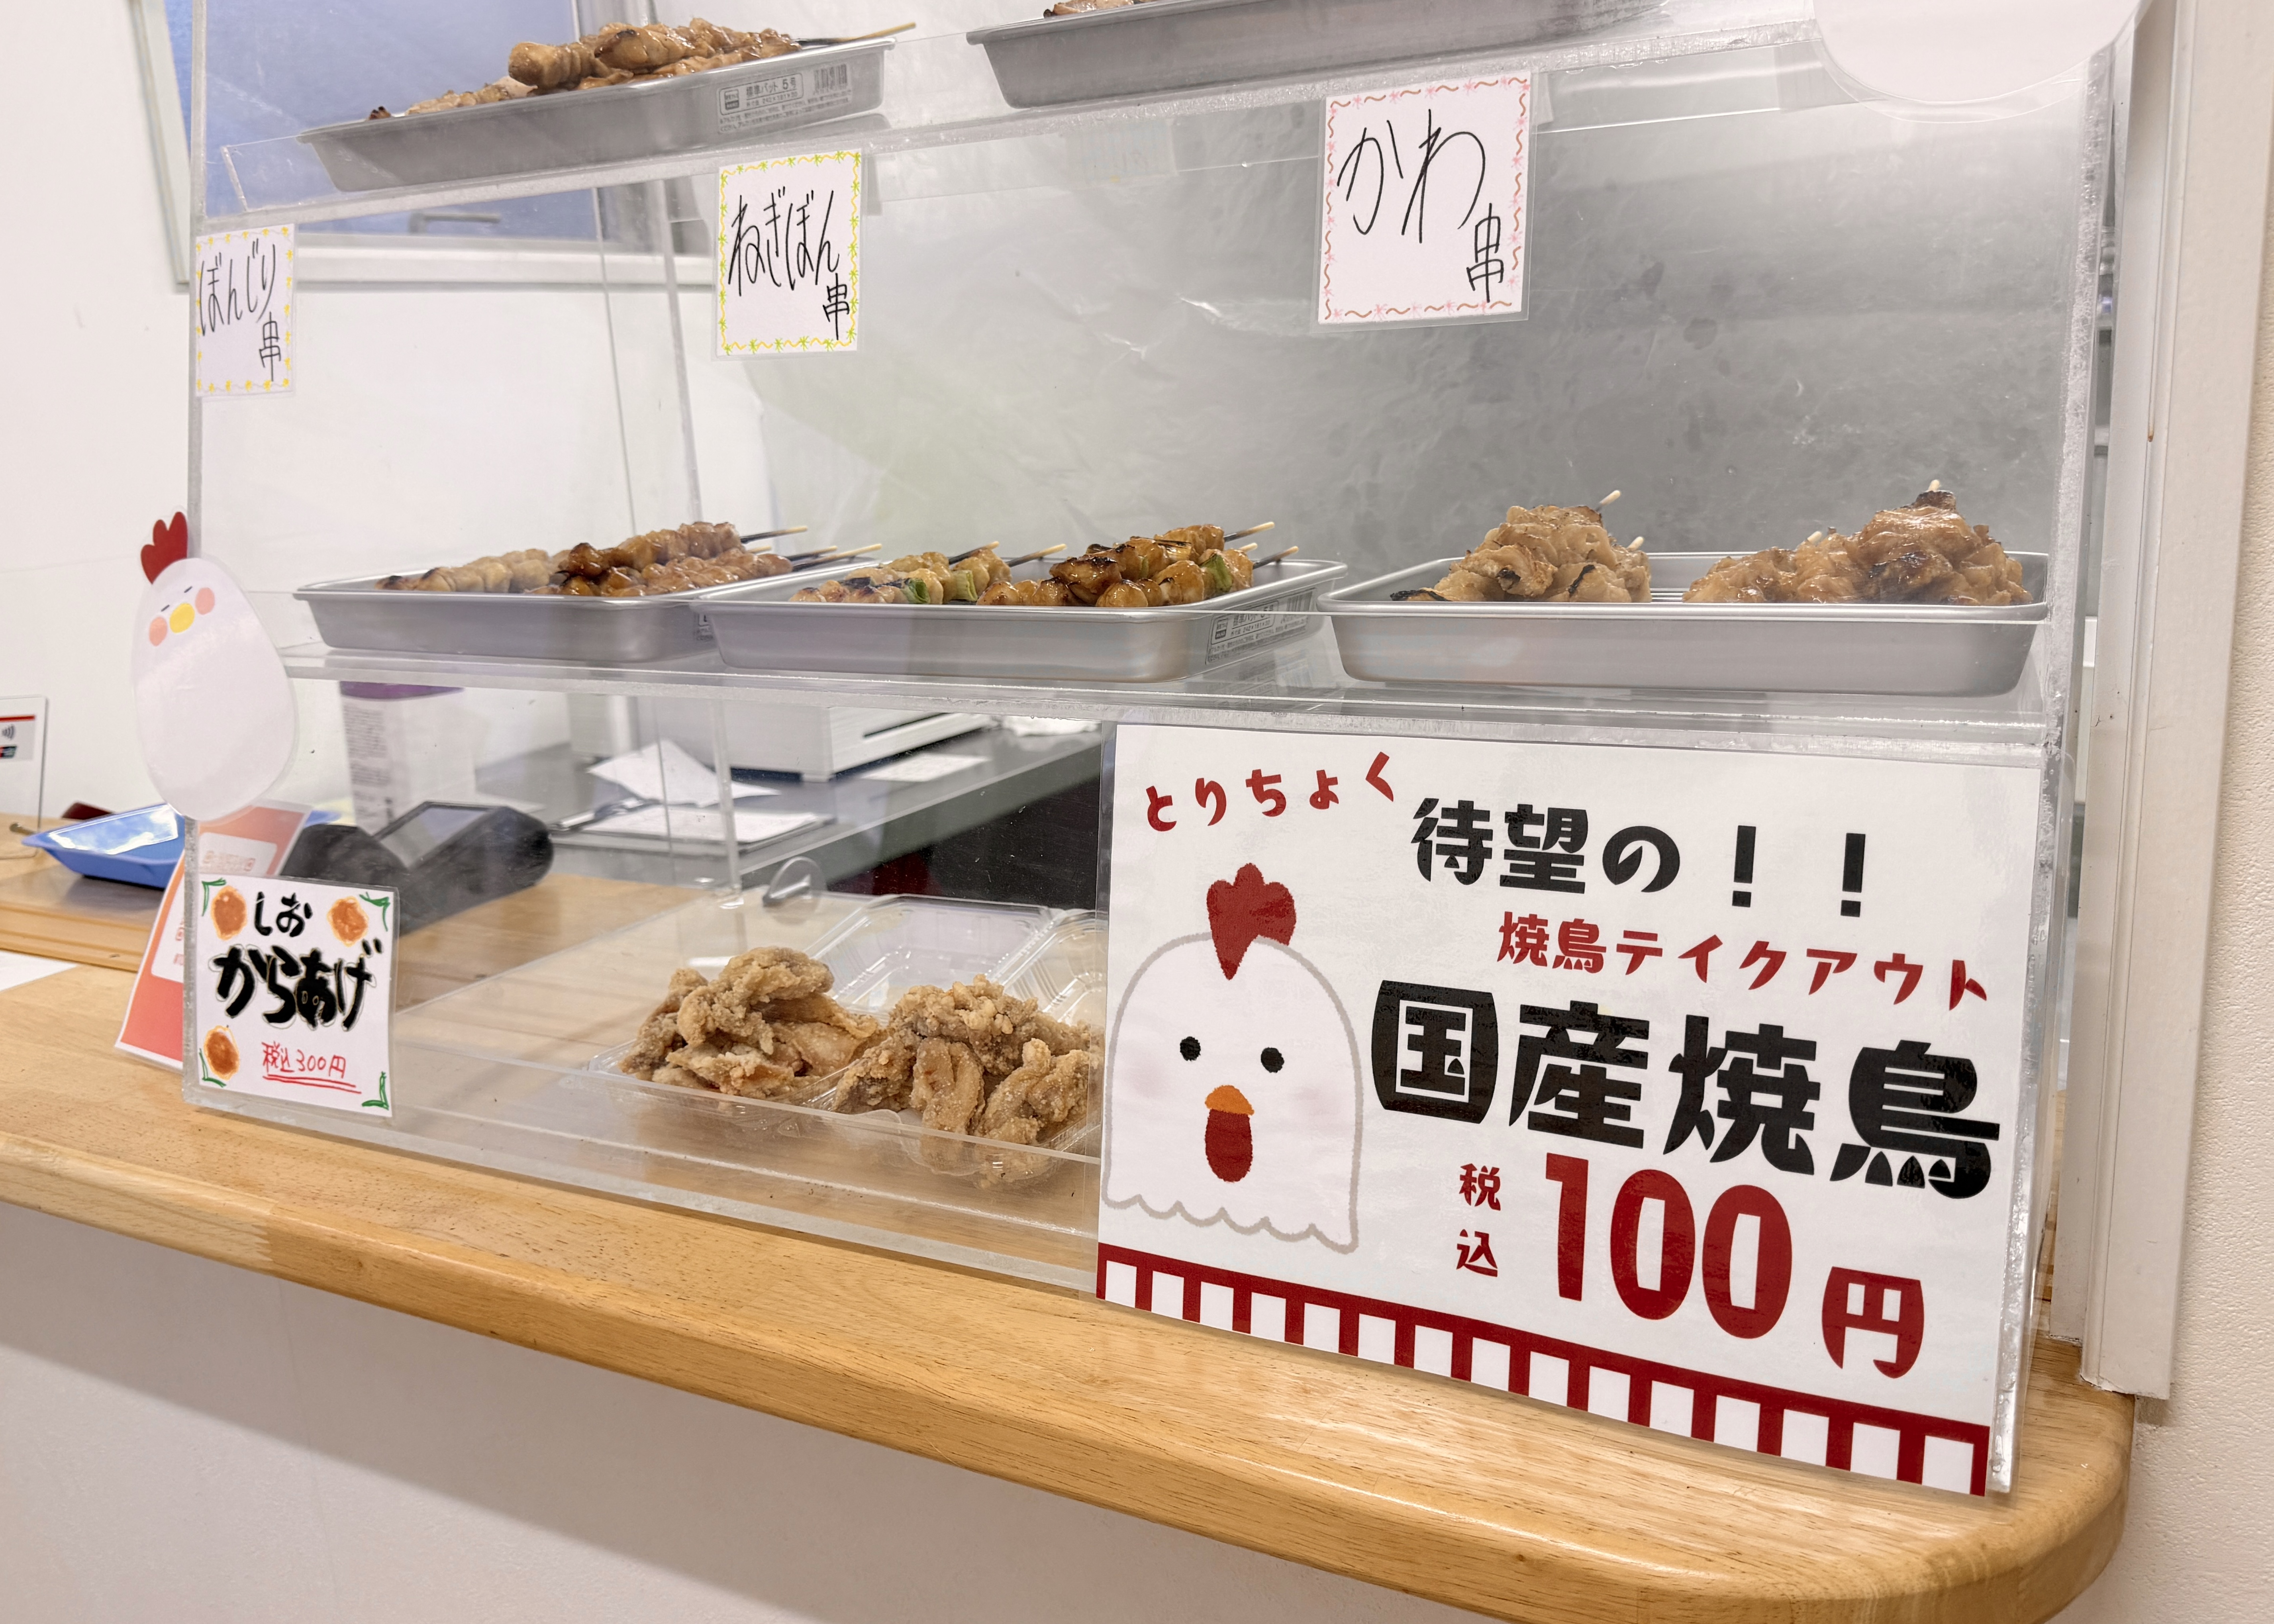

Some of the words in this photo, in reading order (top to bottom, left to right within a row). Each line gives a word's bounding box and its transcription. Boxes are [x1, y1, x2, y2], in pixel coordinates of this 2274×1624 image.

[782, 77, 796, 90] 5号
[1337, 109, 1486, 244] かわ
[200, 238, 276, 337] ぼんじり
[728, 186, 839, 297] ねぎぼん
[1466, 203, 1504, 303] 串
[259, 311, 281, 382] 串
[823, 273, 849, 340] 串
[1146, 752, 1394, 832] とりちょく
[254, 891, 313, 937] しお
[1496, 911, 1988, 1011] 焼鳥テイクアウト
[210, 938, 383, 1032] からあげ
[261, 1041, 347, 1078] 税込300円
[1370, 979, 2000, 1199] 国産焼鳥
[1456, 1163, 1502, 1277] 税込
